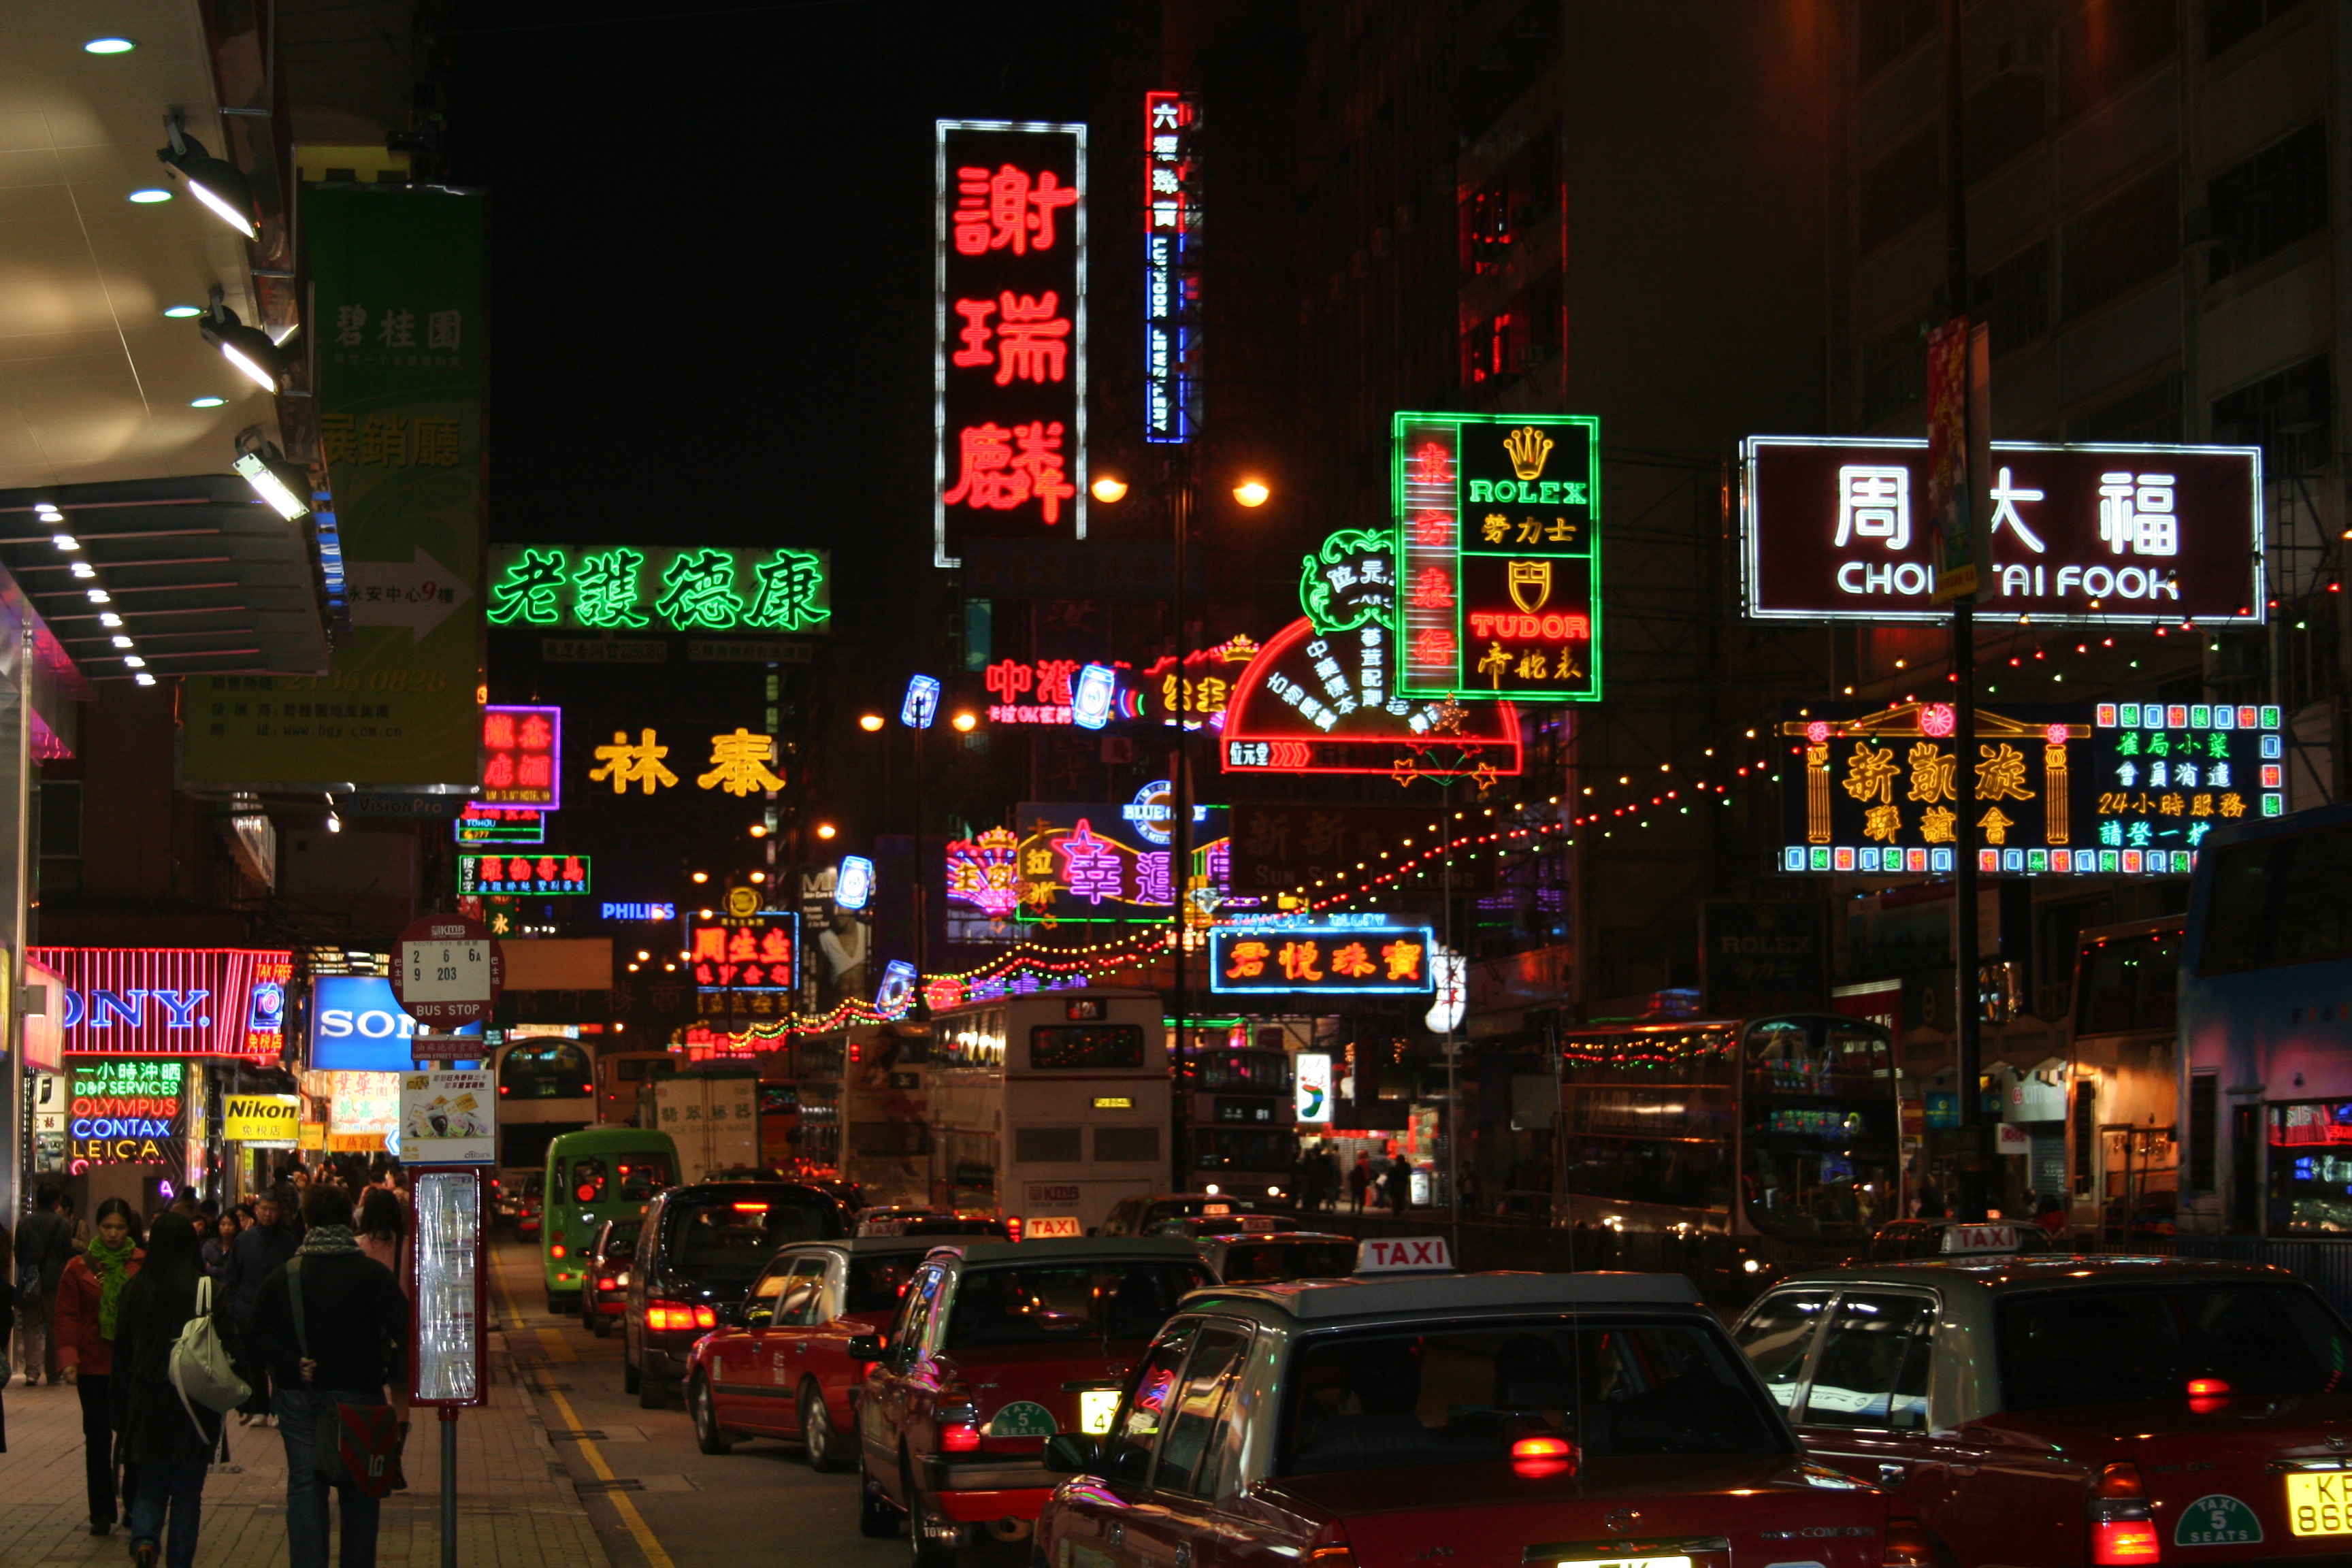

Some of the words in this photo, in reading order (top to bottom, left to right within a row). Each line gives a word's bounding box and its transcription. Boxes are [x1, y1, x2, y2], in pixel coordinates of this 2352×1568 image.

[943, 164, 1078, 524] 謝瑞麟
[1469, 480, 1588, 504] ROLEX
[1834, 465, 2178, 556] 周大福
[1481, 514, 1576, 544] 勞力士
[1326, 559, 1395, 593] 位元
[1837, 562, 1935, 595] CHO
[2057, 566, 2178, 600] FOOK
[1470, 614, 1589, 639] TUDOR
[1842, 741, 2036, 804] 新凱旋
[1123, 804, 1165, 821] BLUE
[2097, 791, 2248, 818] 24小時服務
[442, 925, 466, 935] KMB
[692, 927, 791, 964] 周生生
[413, 950, 420, 964] 2
[443, 949, 450, 963] 6
[468, 948, 481, 962] 6A
[414, 968, 421, 981] 9
[437, 966, 457, 981] 203
[416, 1004, 442, 1017] BUS
[448, 1004, 480, 1016] STOP
[320, 1010, 451, 1038] SON
[75, 1081, 106, 1096] D&P
[109, 1081, 178, 1096] SERVICES
[72, 1097, 178, 1117] OLYMPUS
[229, 1100, 297, 1119] Nikon
[1256, 1109, 1270, 1120] 81
[73, 1118, 171, 1138] CONTAX
[72, 1139, 159, 1158] LEICA
[1044, 1186, 1079, 1201] KMB
[1032, 1220, 1075, 1234] TAXI
[1957, 1226, 2016, 1250] TAXI
[1371, 1241, 1444, 1265] TAXI
[1001, 1403, 1041, 1418] TAXI
[1017, 1412, 1029, 1426] 5
[1001, 1427, 1046, 1435] SEATS
[2197, 1498, 2237, 1513] TAXI
[2210, 1509, 2227, 1530] 5
[2191, 1531, 2249, 1543] SEATS
